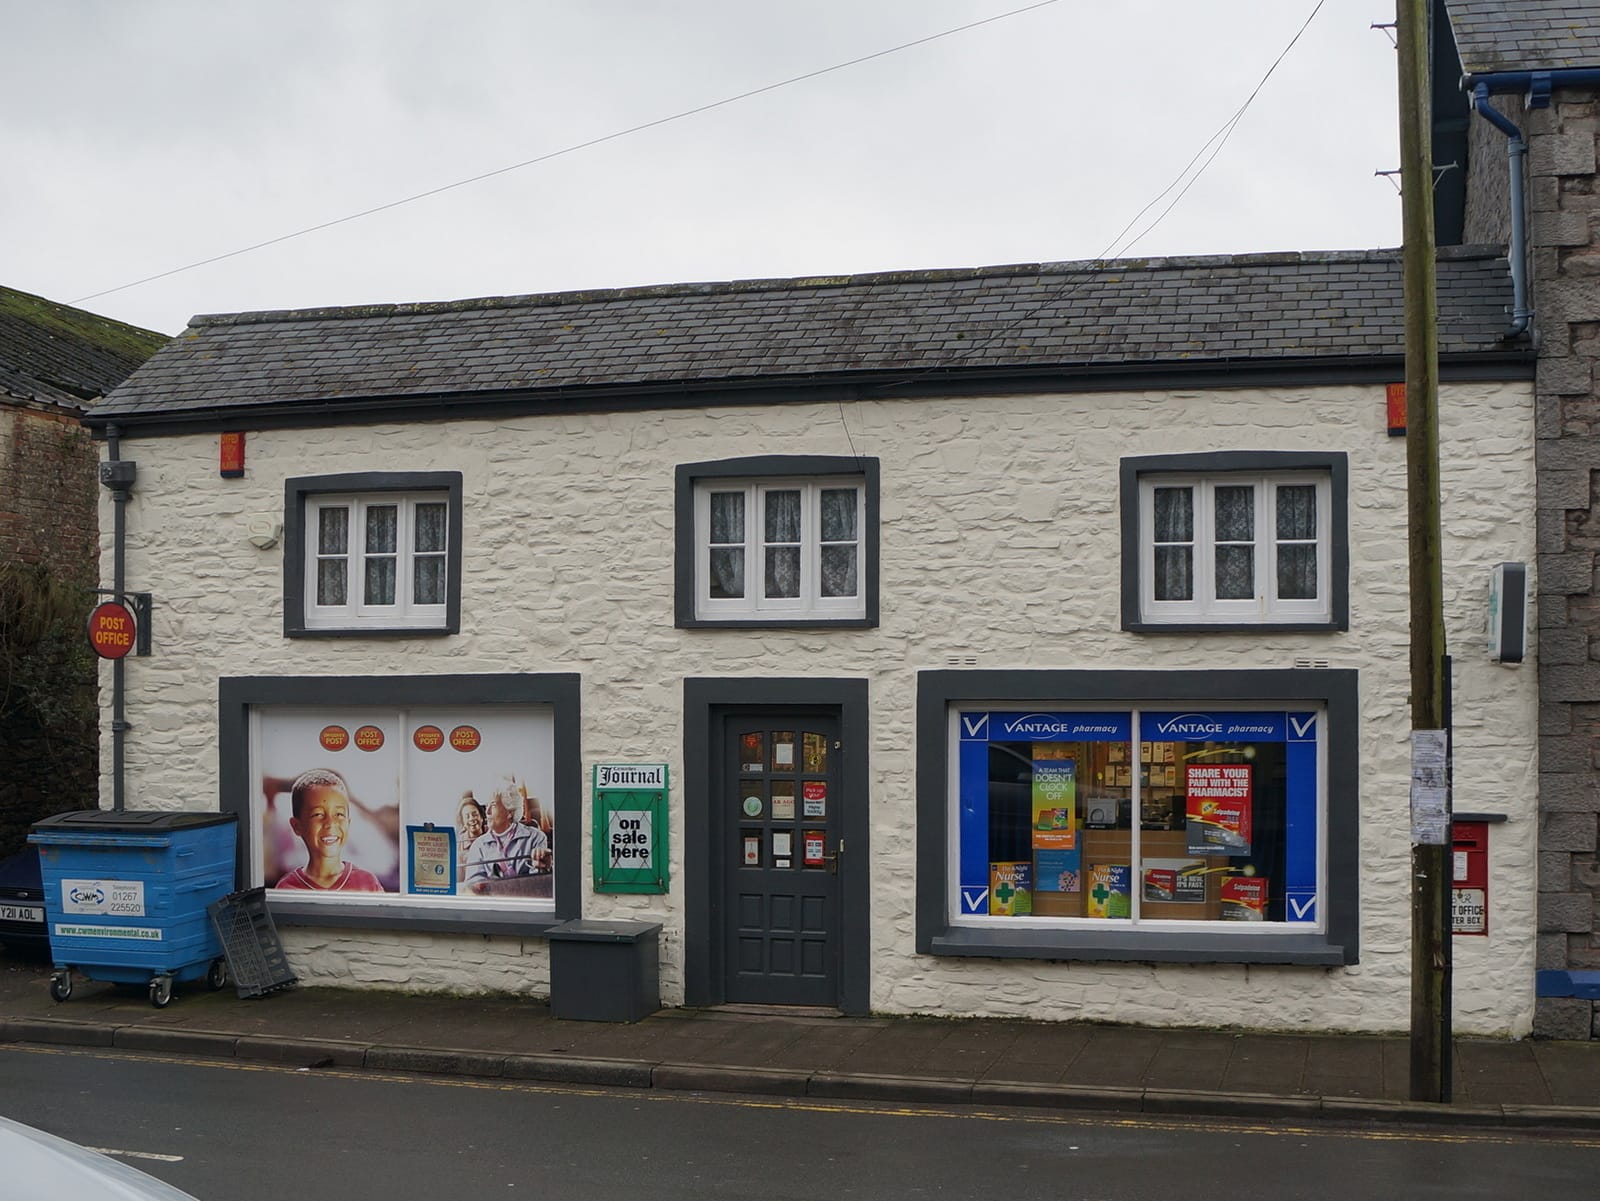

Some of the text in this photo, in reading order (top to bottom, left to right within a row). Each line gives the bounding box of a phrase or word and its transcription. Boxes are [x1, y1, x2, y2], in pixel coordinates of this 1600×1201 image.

[100, 616, 125, 630] POST
[95, 631, 129, 645] OFFICE
[1004, 719, 1118, 734] VANTAGE pharmacy
[1157, 719, 1274, 734] VANTAGE pharmacy
[455, 731, 474, 739] POST
[325, 737, 344, 745] POST
[357, 738, 381, 746] OFFICE
[419, 737, 439, 745] POST
[452, 738, 477, 746] OFFICE
[599, 767, 662, 786] Journal
[1188, 768, 1249, 778] SHARE YOUR
[1035, 774, 1072, 782] DOESN'T
[1039, 783, 1068, 792] CLOCK
[1188, 779, 1249, 787] PAIN WITH THE
[1046, 792, 1063, 801] OFF.
[1188, 788, 1248, 797] PHARMACIST
[619, 819, 640, 830] on
[612, 830, 647, 845] sale
[610, 844, 649, 859] here
[995, 871, 1024, 881] Nurse
[1092, 872, 1120, 883] Nurse
[75, 893, 99, 901] CWM
[112, 892, 137, 901] 01267
[111, 903, 140, 912] 225520
[1458, 905, 1484, 915] OFFICE
[1466, 917, 1481, 925] BOX
[60, 927, 160, 938] www.cwmenvironmental.co.uk
